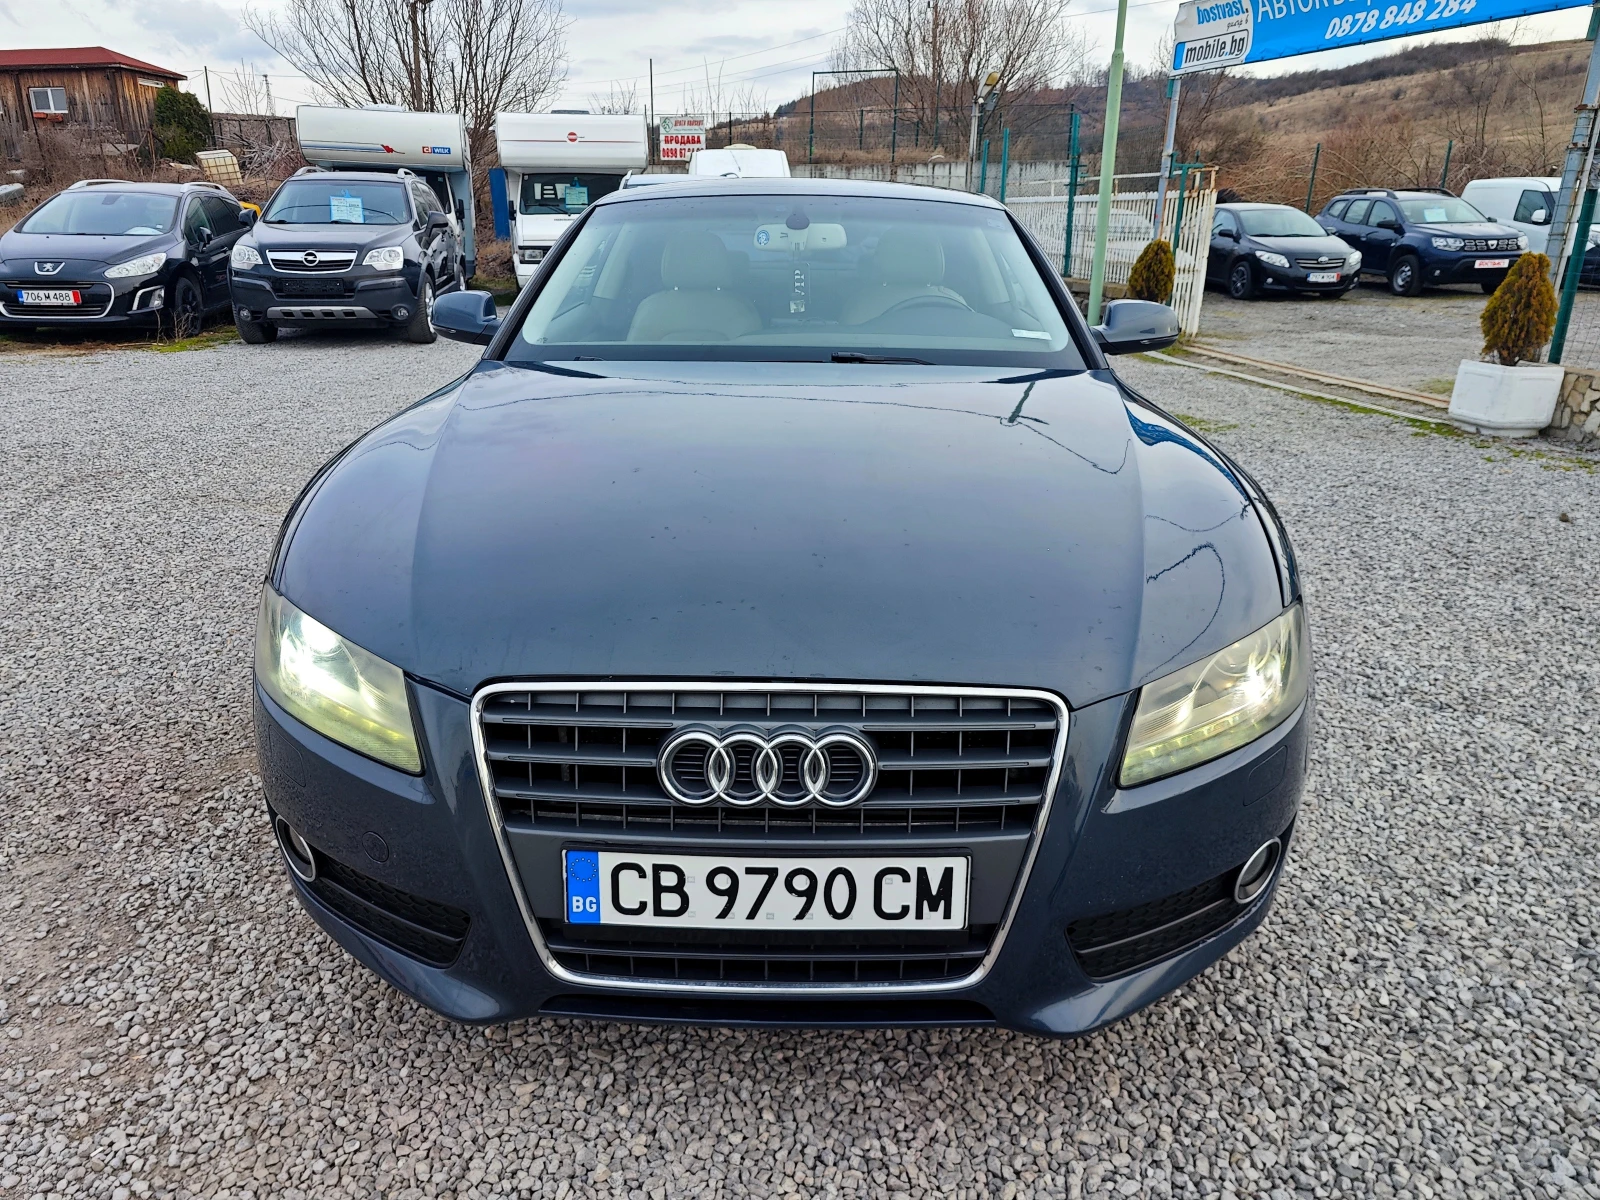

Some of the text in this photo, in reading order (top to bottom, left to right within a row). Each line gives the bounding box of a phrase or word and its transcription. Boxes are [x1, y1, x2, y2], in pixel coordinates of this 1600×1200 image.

[1325, 0, 1478, 40] 0878 848 284
[1185, 35, 1245, 63] mobile.bg
[664, 135, 701, 146] ПРОДАВА
[23, 291, 71, 302] 706 M 488
[610, 861, 953, 921] CB 9790 CM
[572, 896, 597, 913] BG
